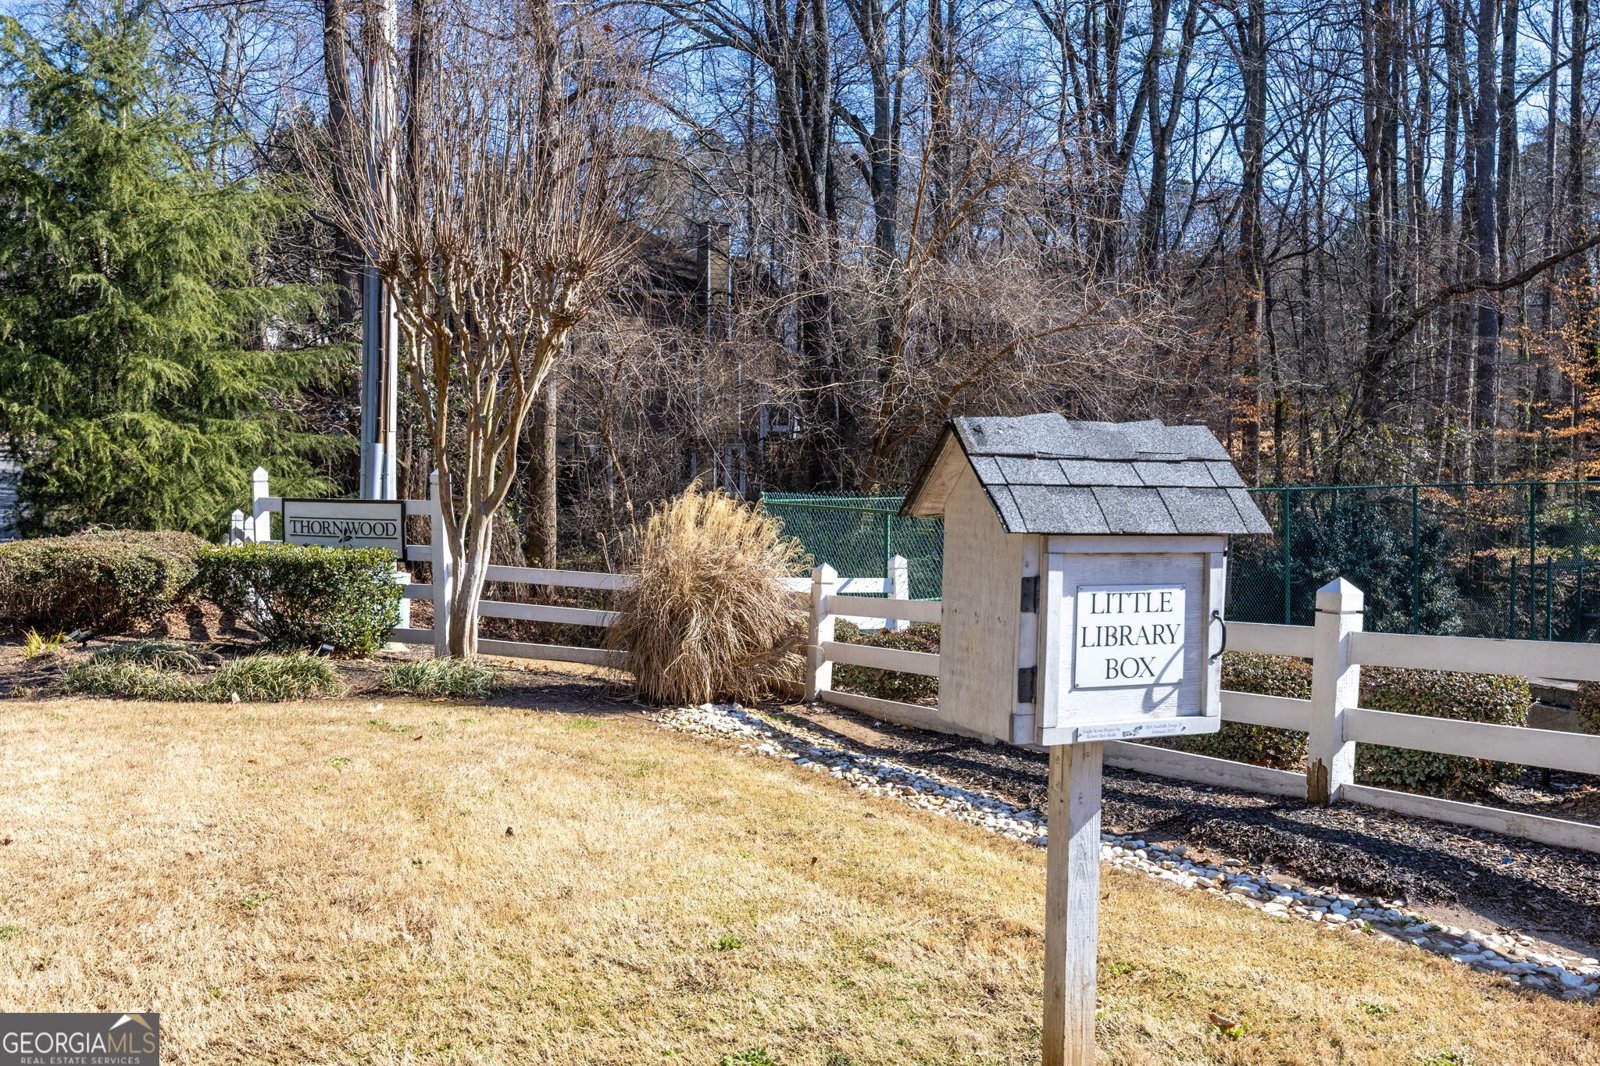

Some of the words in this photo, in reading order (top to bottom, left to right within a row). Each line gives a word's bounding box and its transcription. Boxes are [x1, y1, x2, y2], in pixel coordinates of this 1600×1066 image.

[289, 519, 398, 537] THORNWOOD
[1090, 591, 1173, 615] LITTLE
[1080, 623, 1181, 648] LIBRARY
[1104, 656, 1156, 680] BOX
